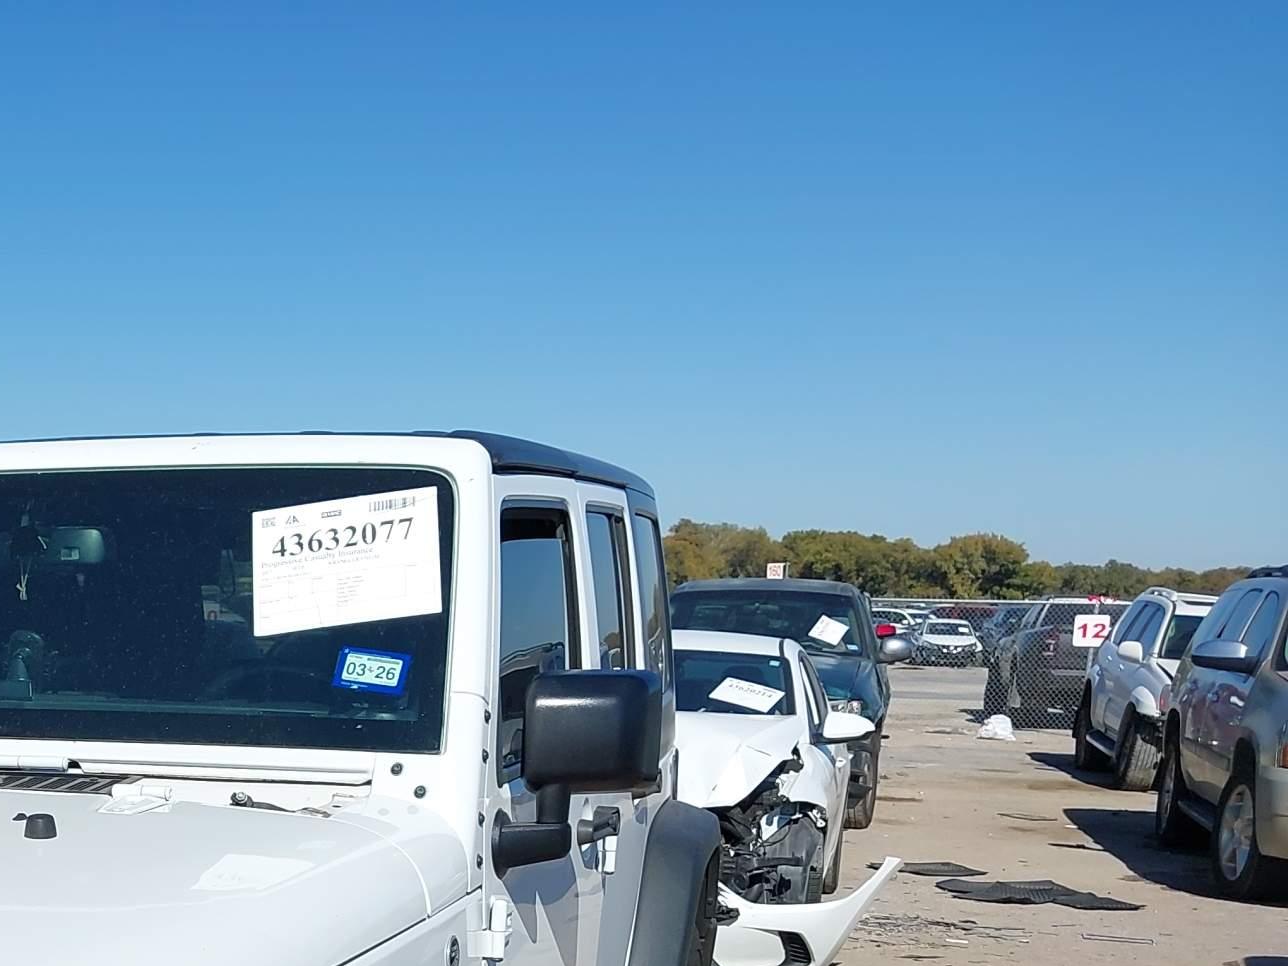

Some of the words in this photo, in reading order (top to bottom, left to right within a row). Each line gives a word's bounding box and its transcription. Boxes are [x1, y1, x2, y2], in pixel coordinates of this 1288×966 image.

[272, 517, 414, 557] 43632077
[261, 556, 303, 569] Progressive
[304, 551, 336, 563] Casualty
[338, 547, 374, 558] Insurance
[1077, 623, 1107, 639] 12
[346, 661, 367, 677] 03
[374, 665, 397, 681] 26
